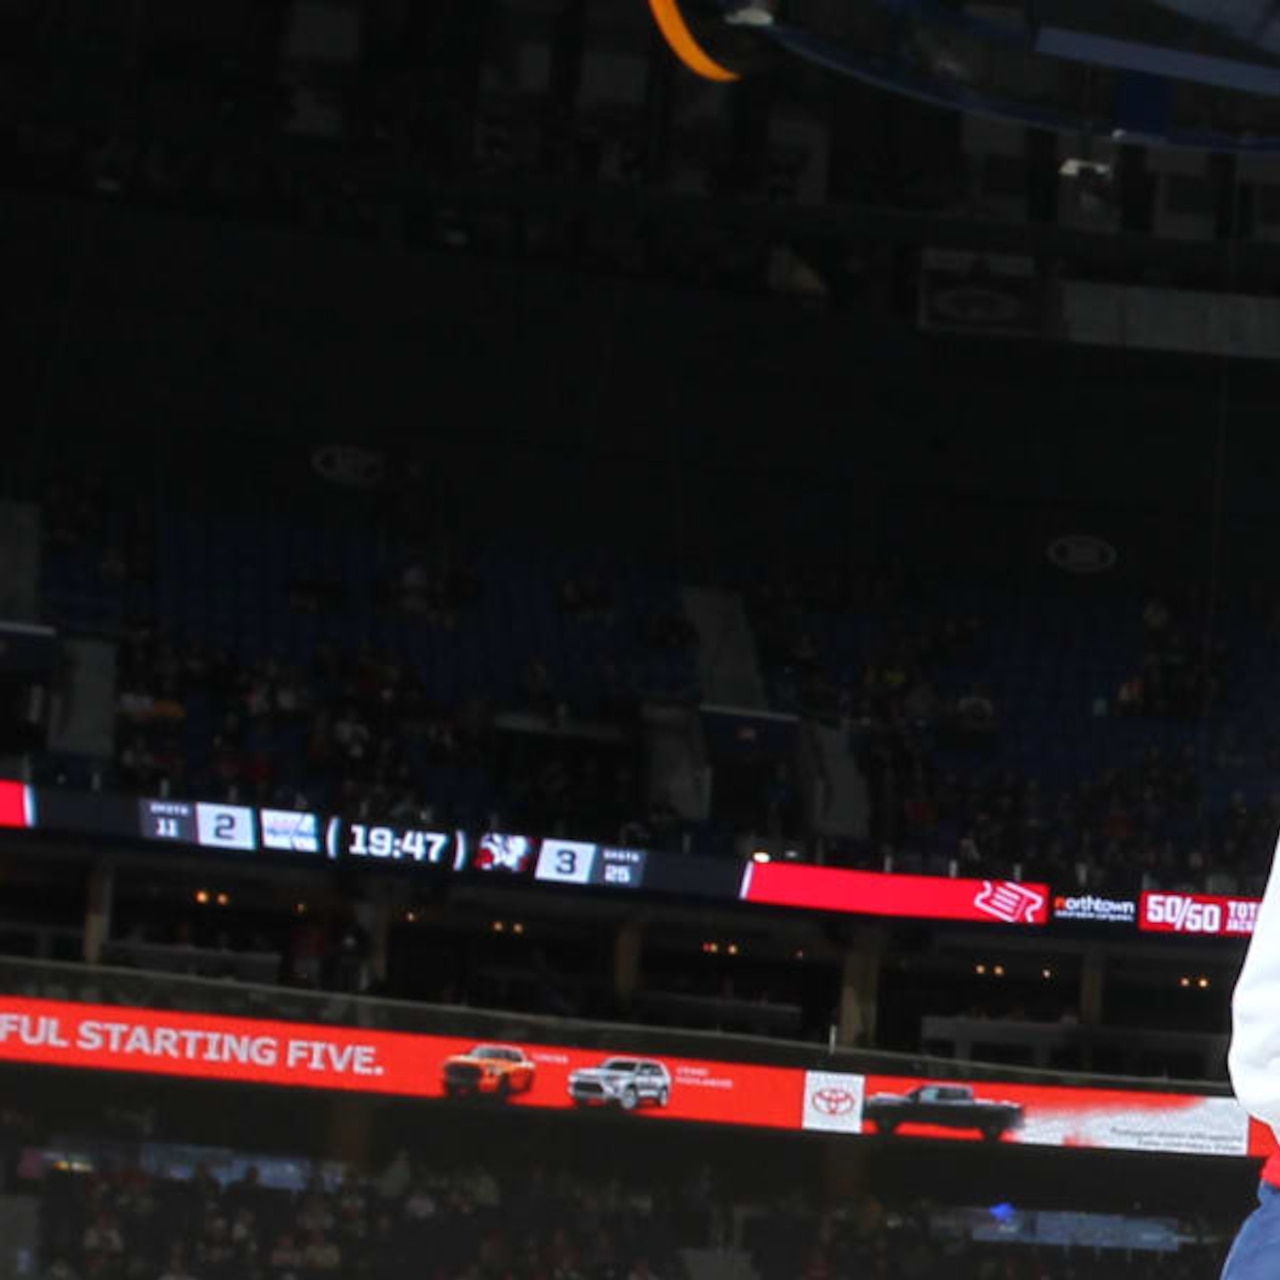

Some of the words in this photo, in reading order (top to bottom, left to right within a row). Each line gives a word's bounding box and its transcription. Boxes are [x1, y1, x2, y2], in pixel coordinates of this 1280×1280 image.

[155, 818, 179, 838] 11
[213, 812, 236, 841] 2
[349, 823, 448, 863] 19:47
[555, 849, 577, 876] 3
[604, 864, 631, 883] 25
[1146, 893, 1222, 934] 50/50
[77, 1019, 278, 1067] STARTING
[286, 1039, 385, 1076] FIVE.
